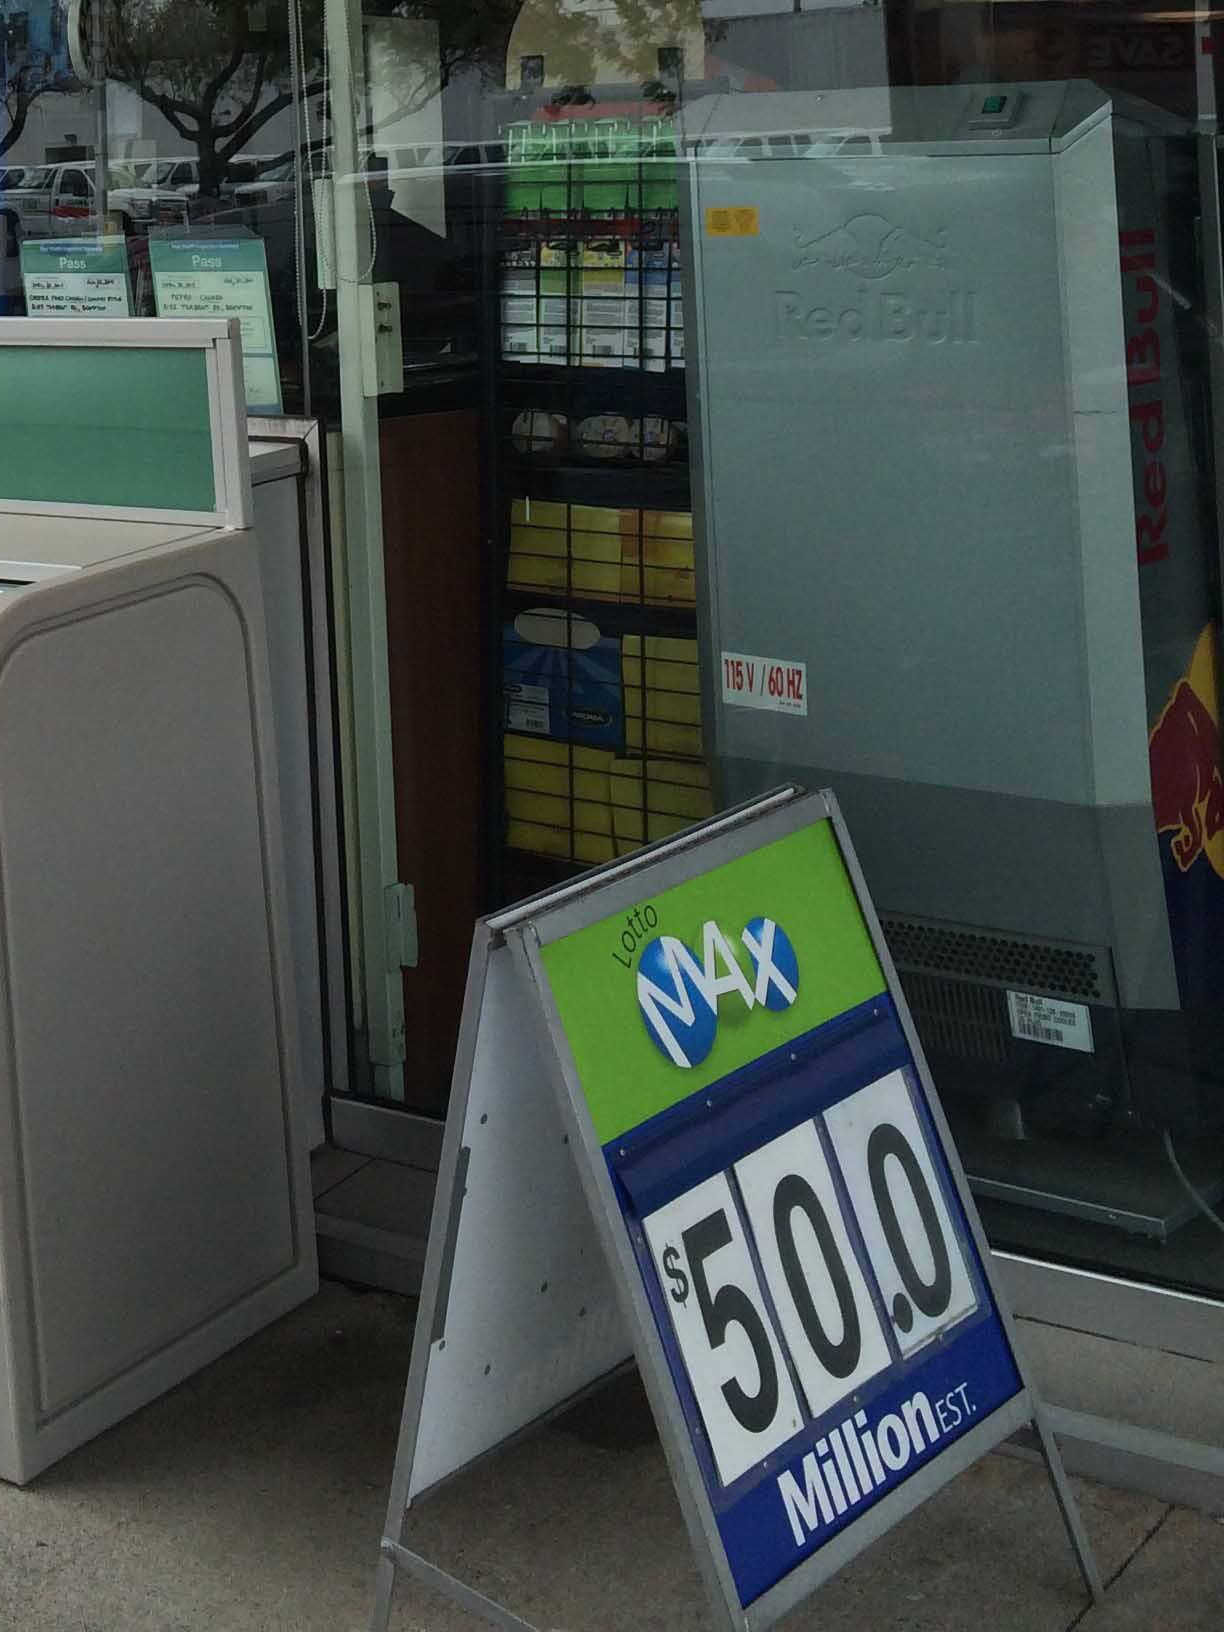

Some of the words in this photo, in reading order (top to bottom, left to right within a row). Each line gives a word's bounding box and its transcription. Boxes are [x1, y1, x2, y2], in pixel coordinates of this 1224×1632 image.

[59, 256, 87, 270] Pass
[191, 255, 223, 268] Pass
[1119, 229, 1161, 385] Bull
[724, 658, 744, 691] 115
[745, 661, 755, 693] V
[787, 667, 803, 700] HZ
[637, 918, 797, 1068] MAX
[777, 1391, 940, 1547] Million
[935, 1382, 977, 1433] EST.
